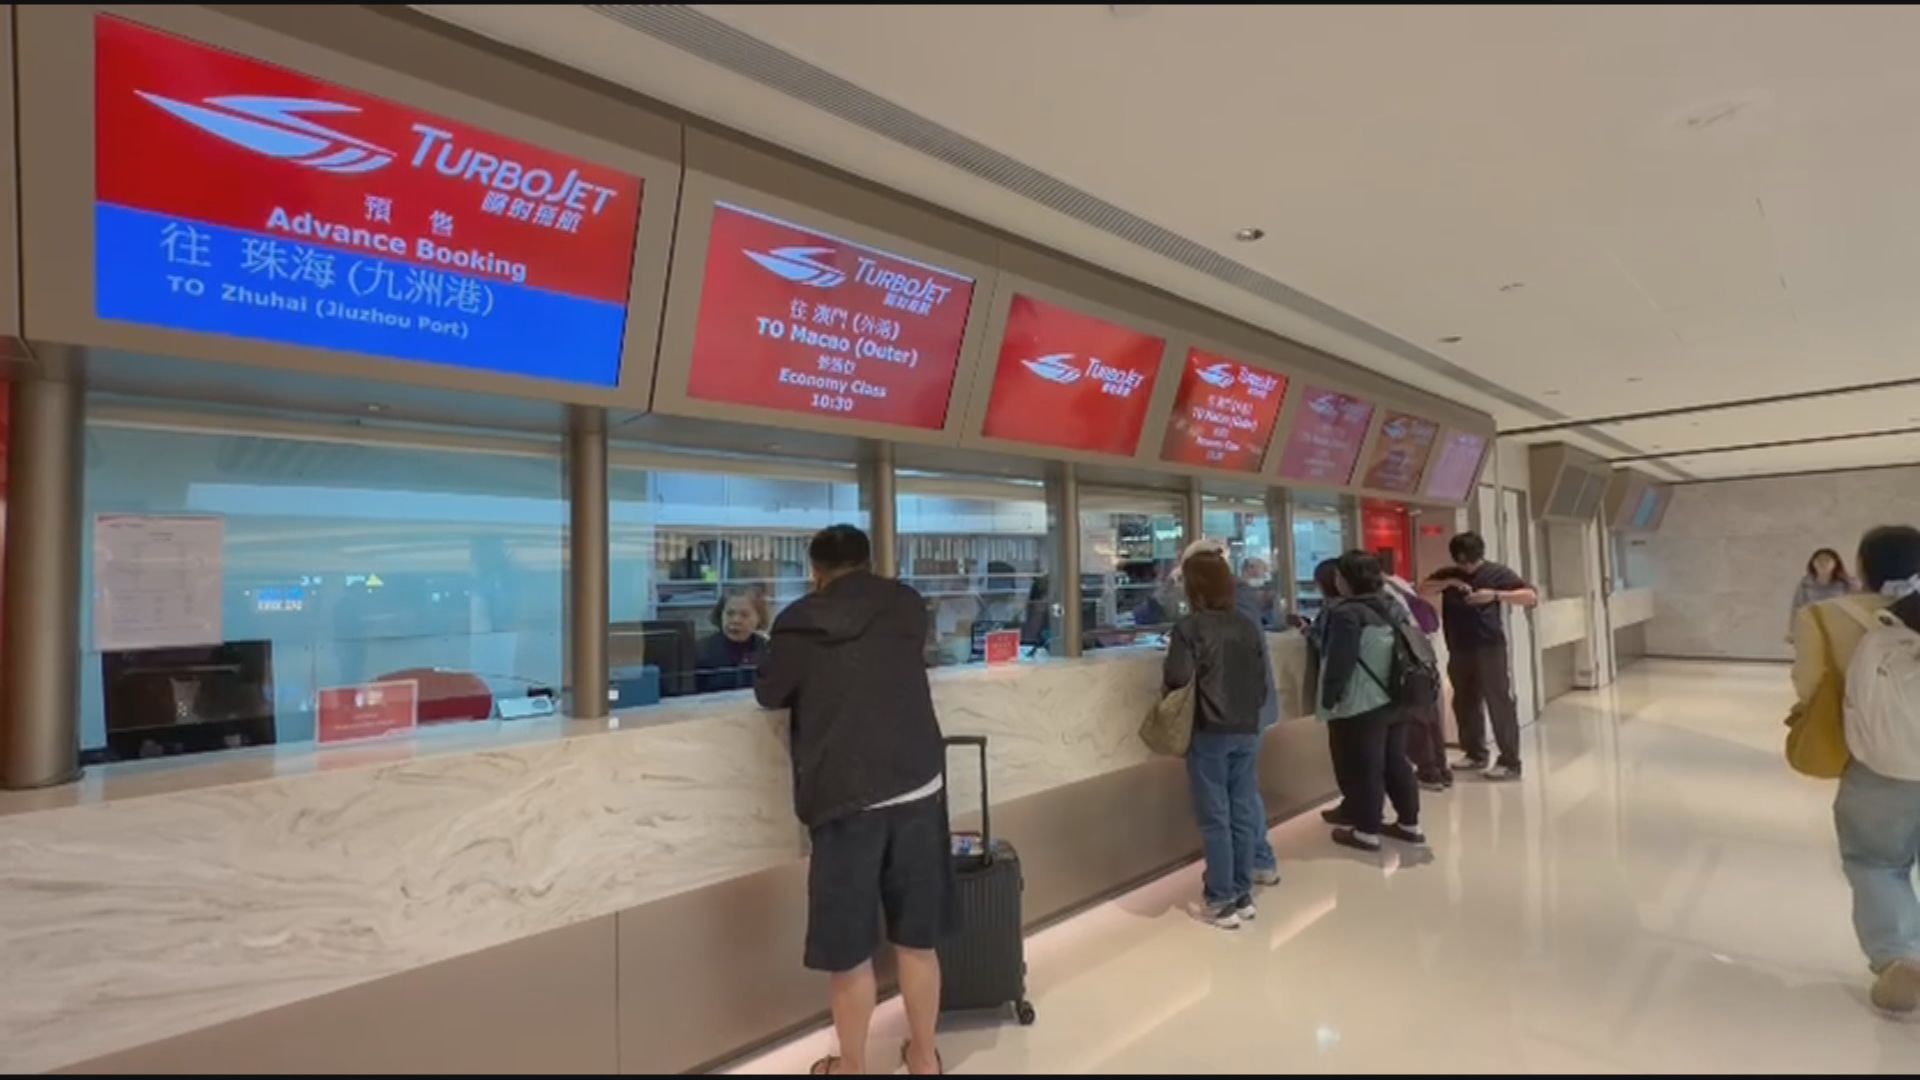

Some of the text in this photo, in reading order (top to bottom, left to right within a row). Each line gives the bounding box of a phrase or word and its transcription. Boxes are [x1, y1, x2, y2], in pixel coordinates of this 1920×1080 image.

[160, 222, 212, 268] 往
[240, 236, 336, 288] 珠海
[266, 206, 528, 282] Advance Booking
[166, 274, 471, 341] TO Zhuhai (Jiuzhou Port)
[757, 315, 785, 338] TO
[855, 336, 919, 368] (Outer)
[778, 366, 888, 398] Economy Class
[810, 393, 854, 411] 10:30
